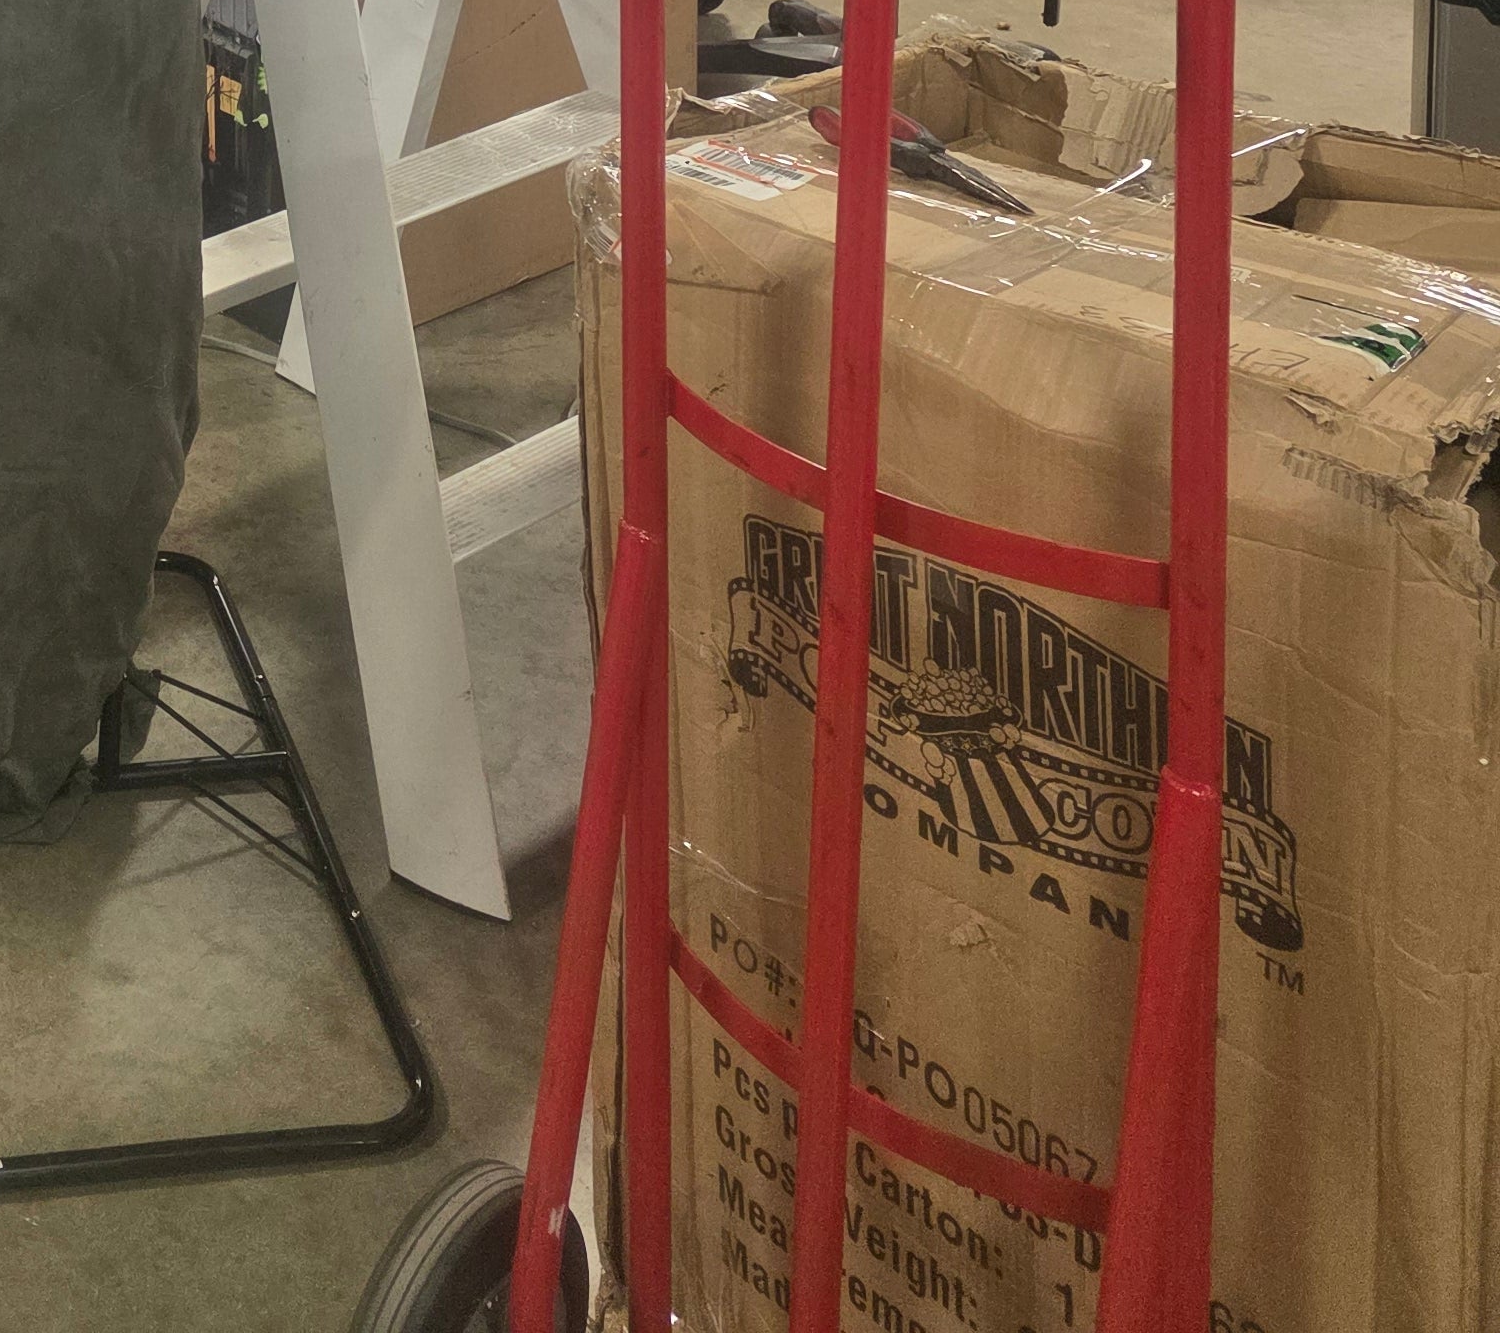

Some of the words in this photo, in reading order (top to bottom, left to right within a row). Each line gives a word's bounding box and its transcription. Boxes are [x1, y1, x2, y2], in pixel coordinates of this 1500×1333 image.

[744, 514, 918, 673] GRT
[924, 563, 1274, 817] NORTHN
[864, 785, 1131, 942] OMPAN
[1051, 776, 1293, 892] CON
[1257, 950, 1305, 996] TM
[714, 1104, 796, 1198] Gros
[854, 1140, 1004, 1280] Carton:
